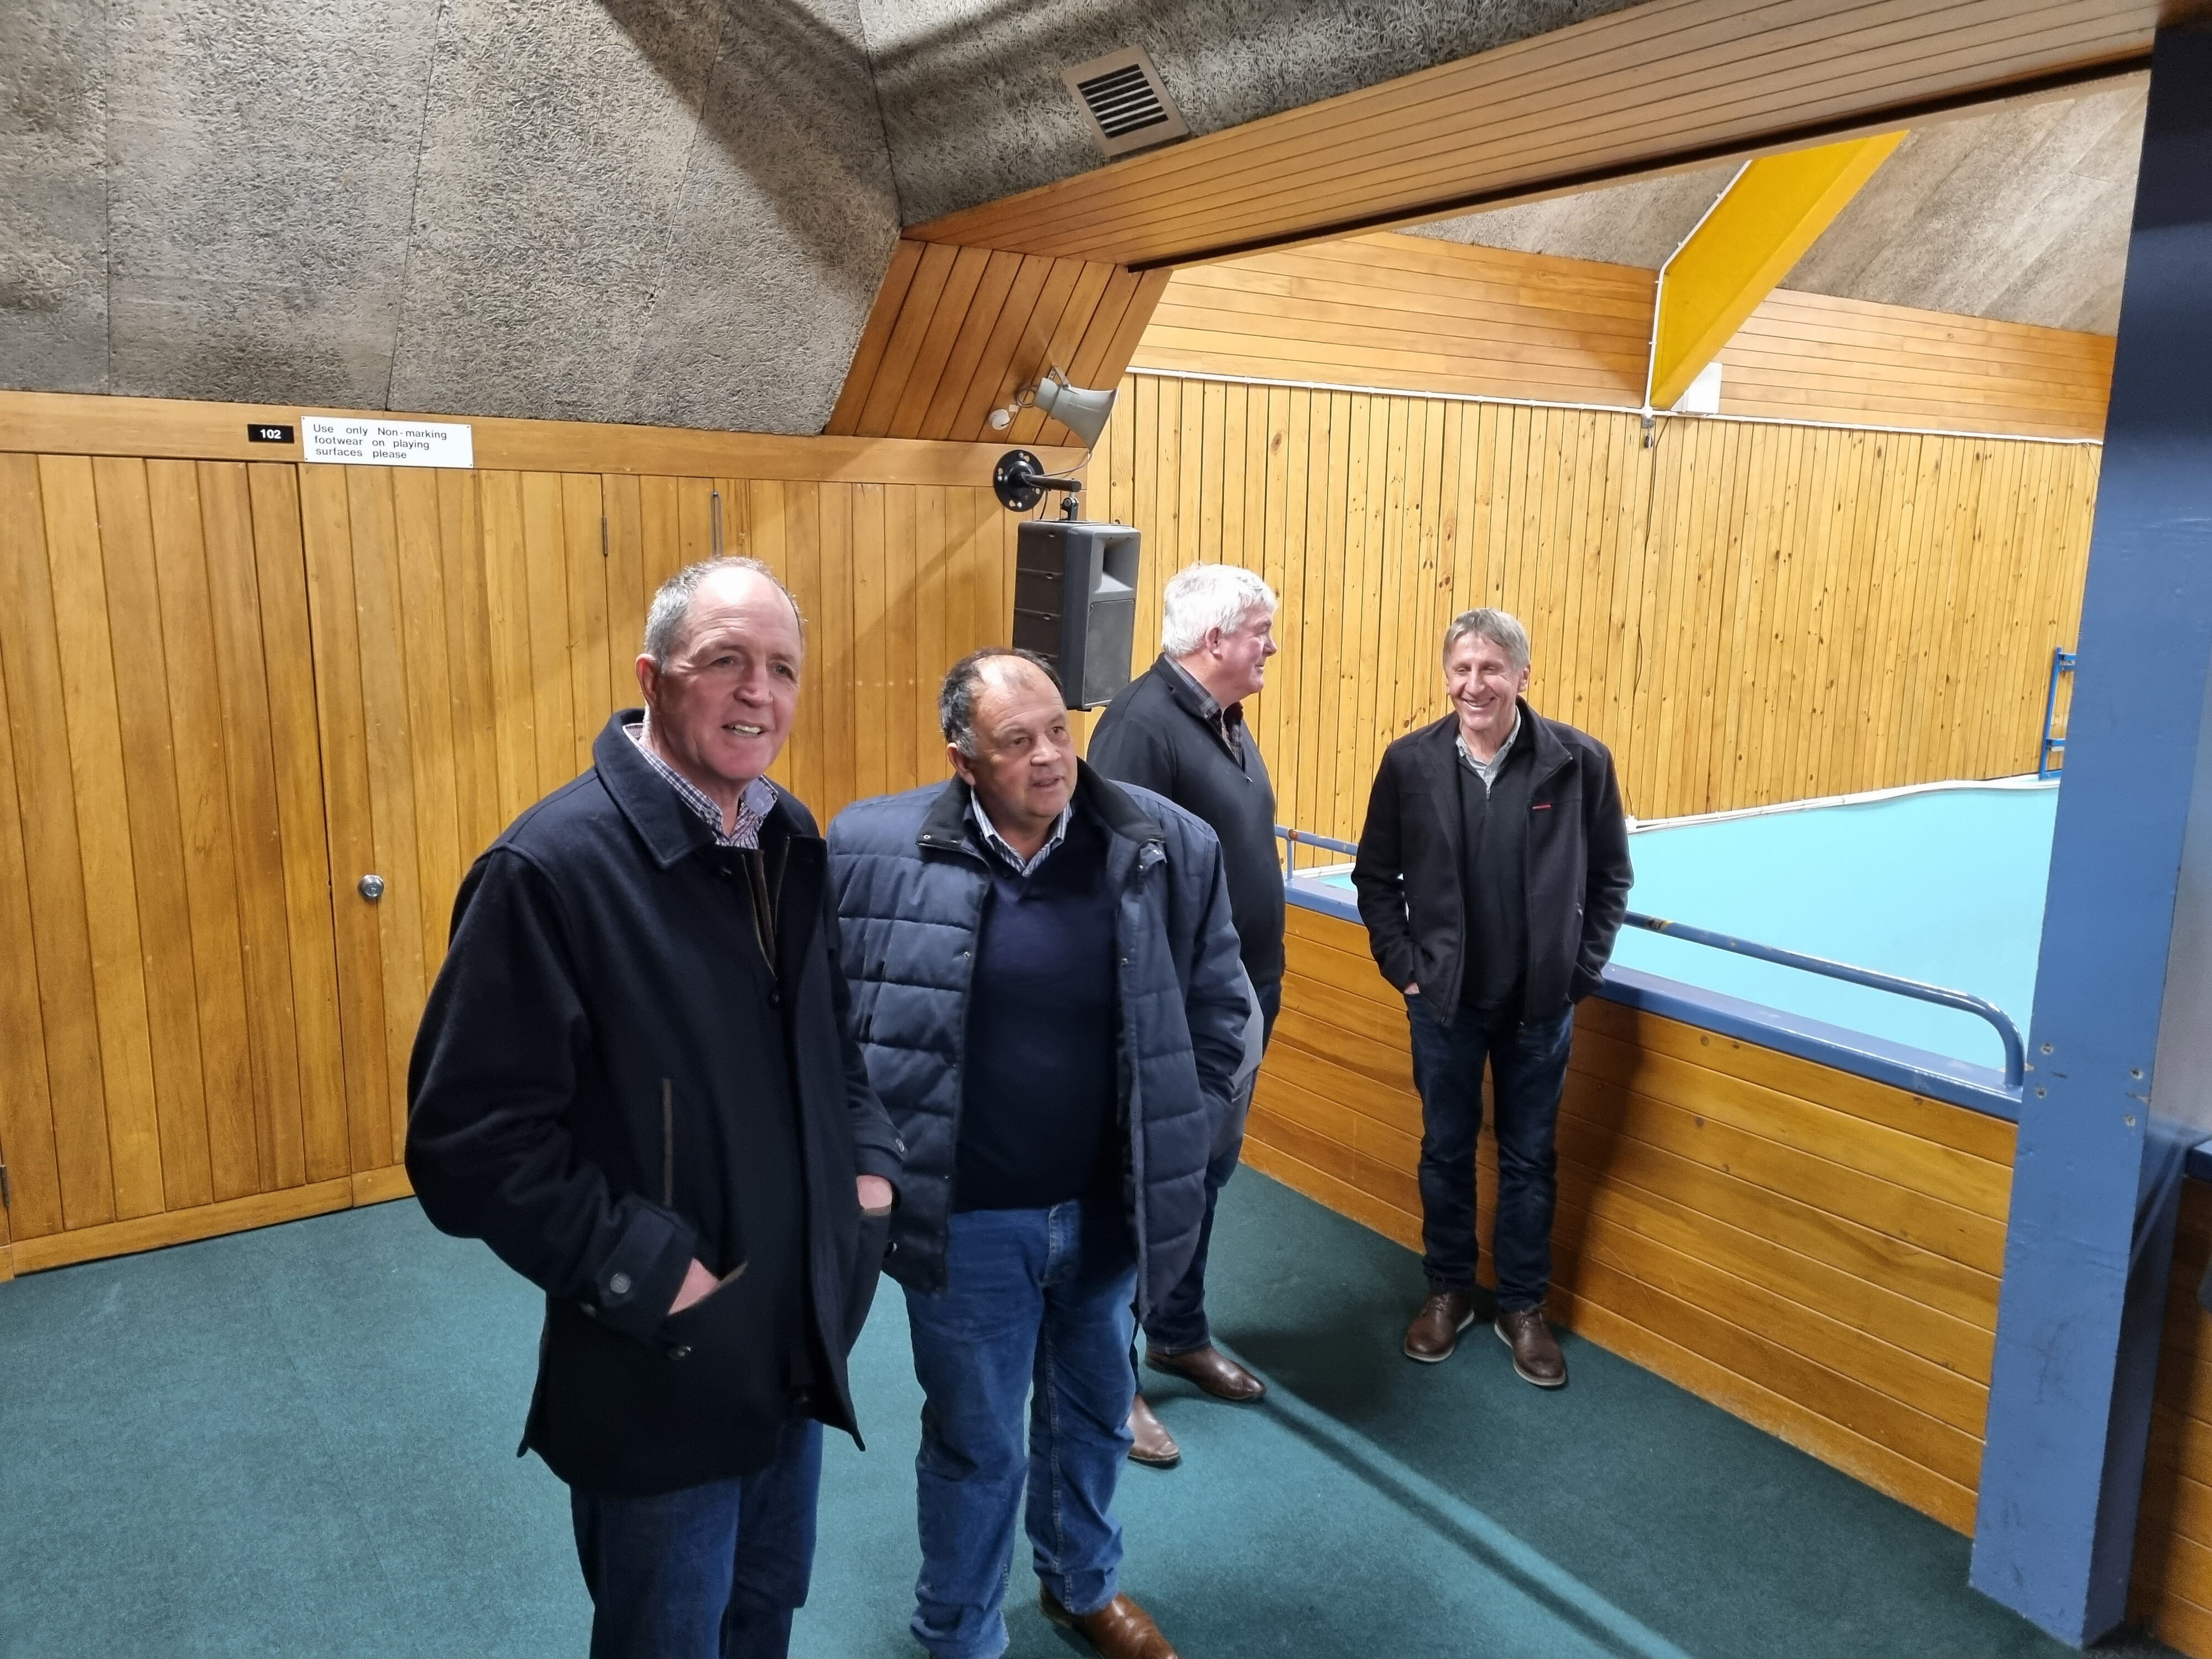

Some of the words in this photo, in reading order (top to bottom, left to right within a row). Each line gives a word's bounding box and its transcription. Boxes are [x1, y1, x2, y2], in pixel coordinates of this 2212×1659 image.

[260, 429, 281, 439] 102
[313, 424, 334, 434] Use
[346, 426, 368, 437] only
[315, 435, 363, 445] footwear
[393, 439, 430, 451] playing
[316, 447, 363, 457] surfaces
[373, 450, 407, 460] please
